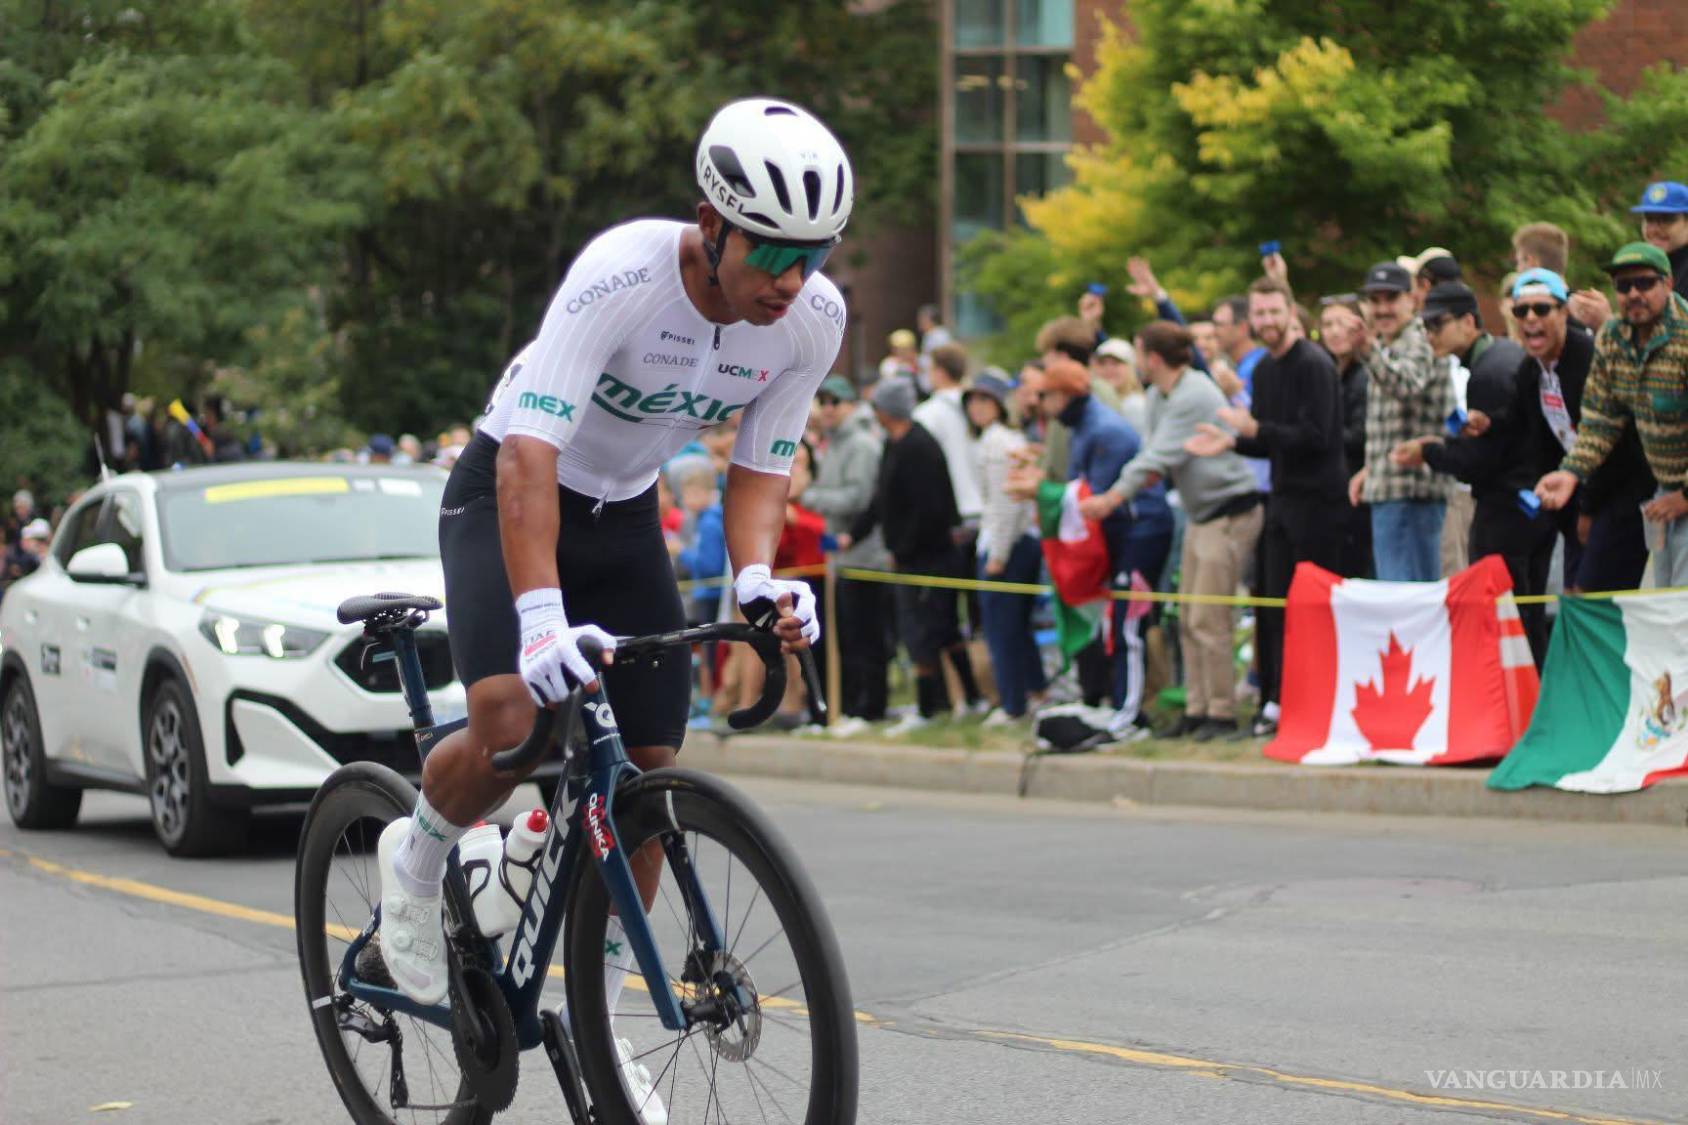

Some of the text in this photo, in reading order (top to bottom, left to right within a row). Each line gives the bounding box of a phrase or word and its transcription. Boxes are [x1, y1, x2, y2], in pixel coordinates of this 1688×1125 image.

[566, 267, 652, 314] CONADE
[643, 352, 699, 367] CONADE
[512, 780, 578, 989] QUICK
